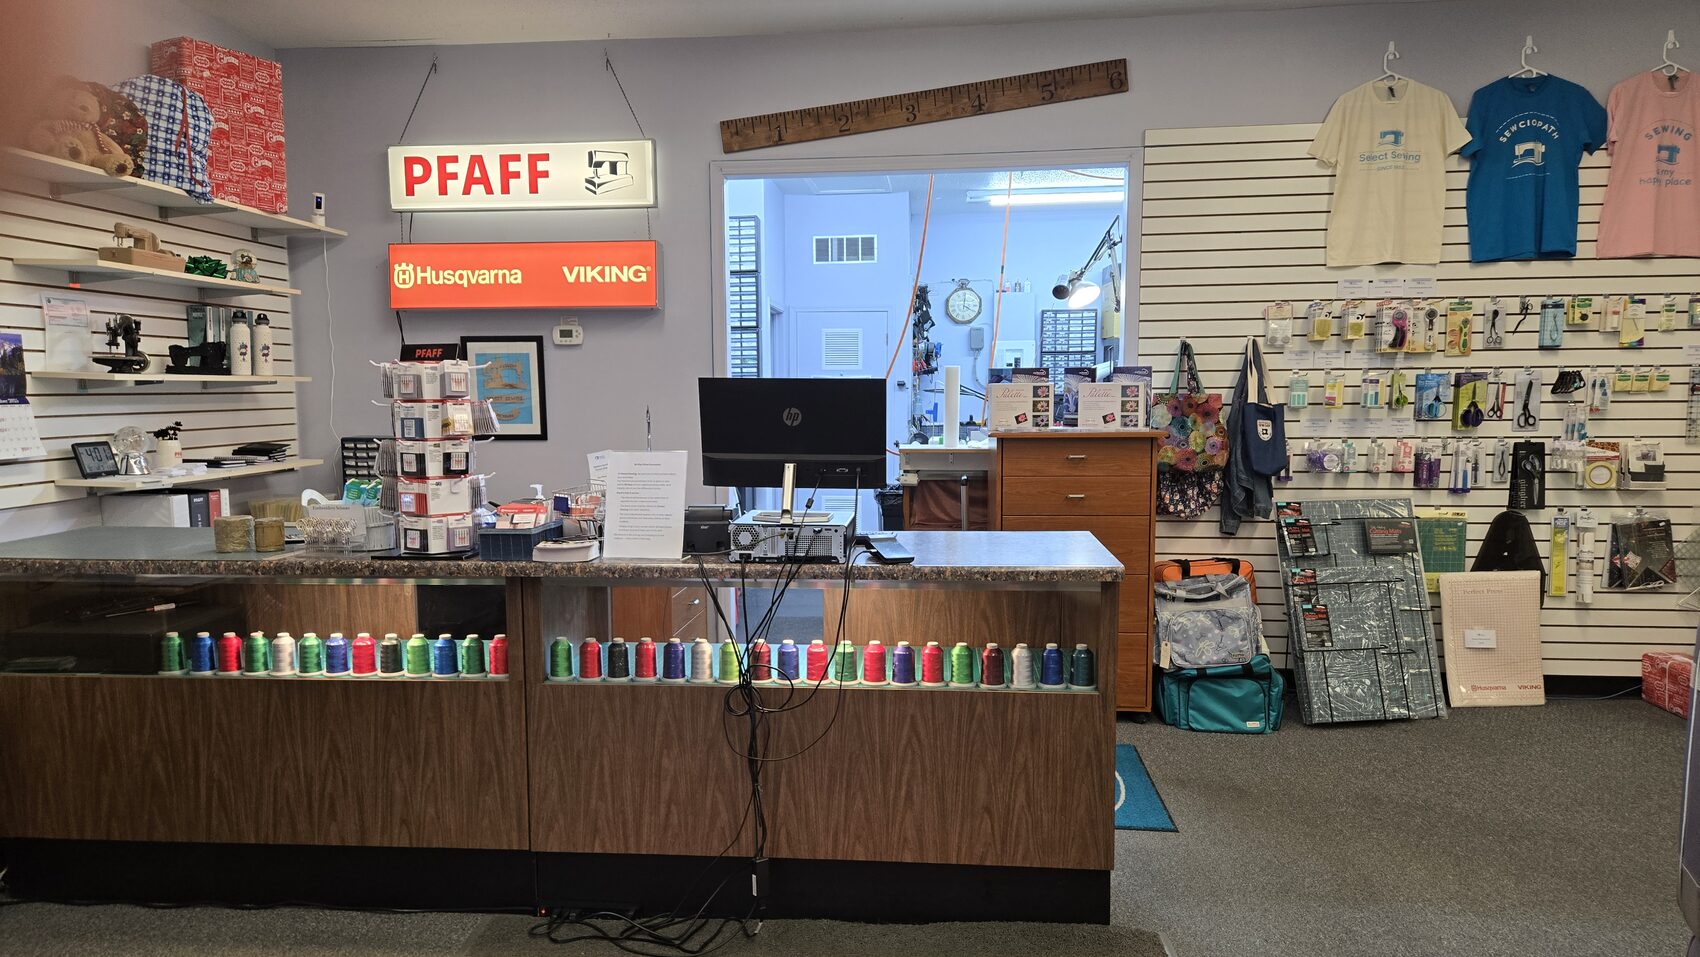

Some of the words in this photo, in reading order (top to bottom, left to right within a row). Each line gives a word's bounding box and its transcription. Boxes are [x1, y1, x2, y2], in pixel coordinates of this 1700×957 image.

[772, 126, 785, 143] 1
[838, 114, 851, 133] 2
[905, 104, 918, 123] 3
[970, 94, 986, 114] 4
[1041, 83, 1055, 101] 5
[1110, 70, 1123, 90] 6
[1499, 119, 1559, 142] SEWCIOPATH
[1645, 125, 1692, 141] SEWING
[1360, 152, 1388, 162] Select
[403, 153, 550, 197] PFAFF
[1665, 178, 1692, 188] place
[416, 265, 523, 288] Husqvarna
[562, 264, 648, 284] VIKING
[415, 348, 443, 358] PFAFF
[784, 408, 801, 426] hp
